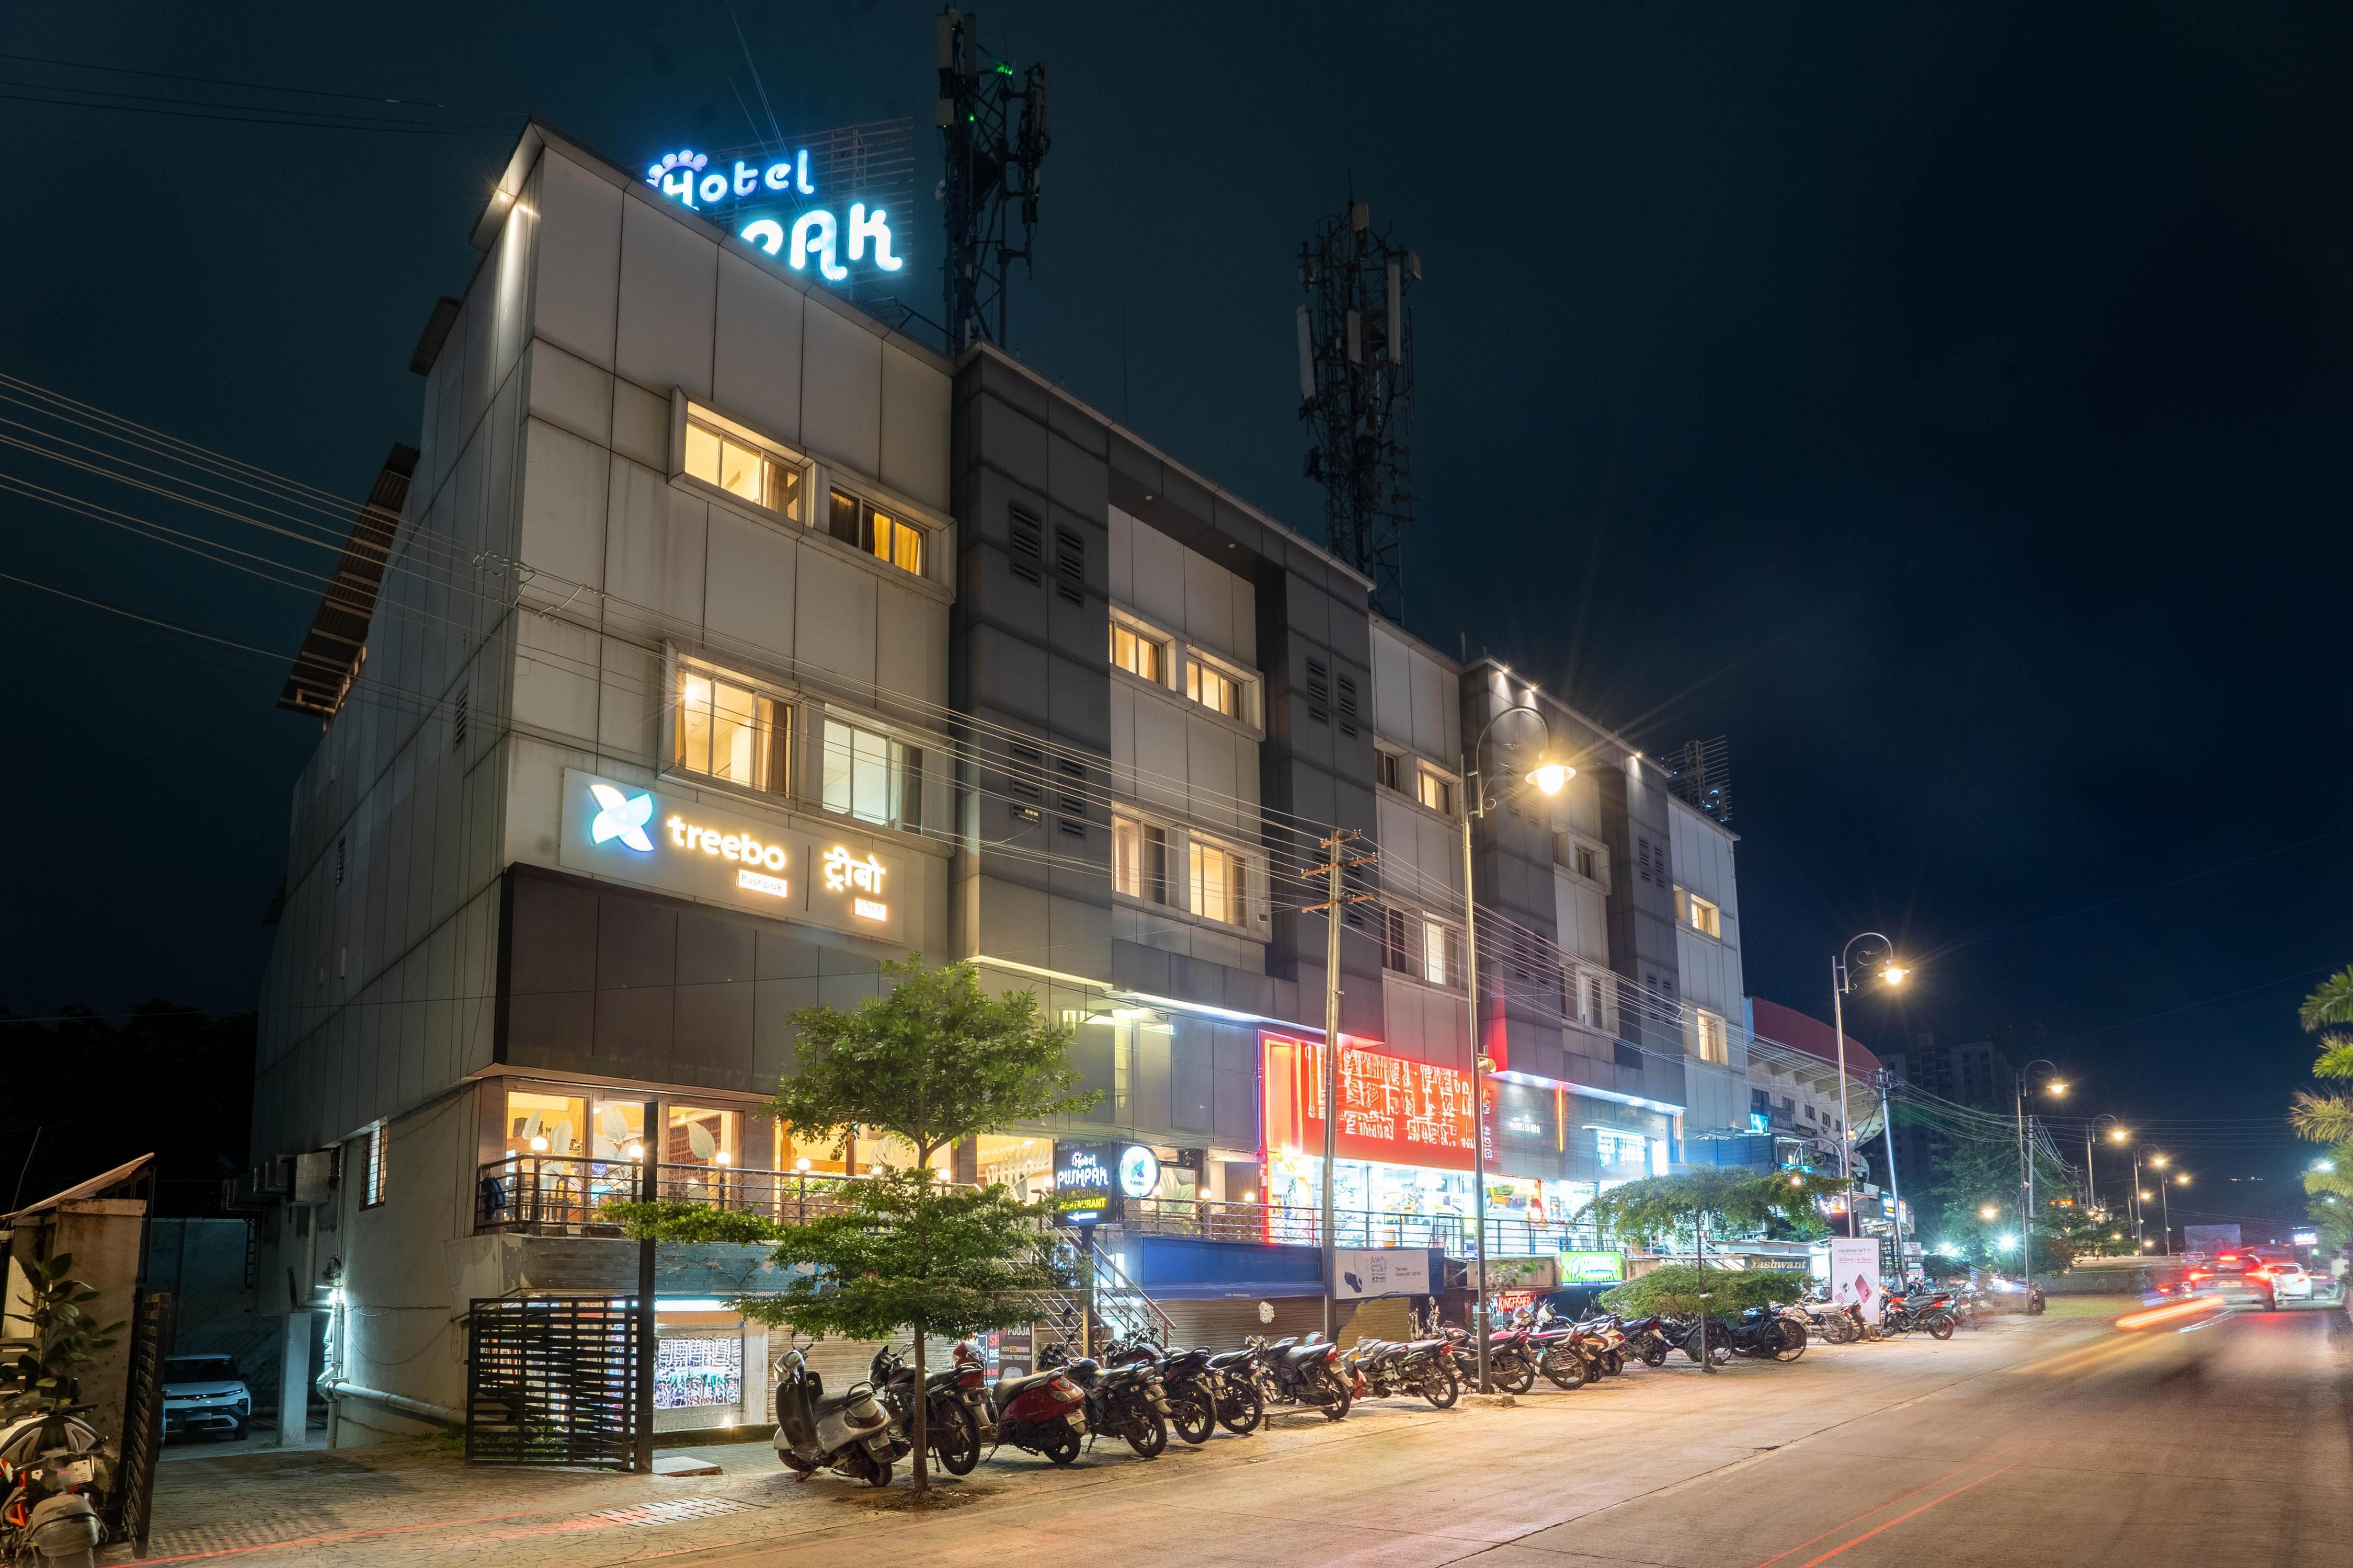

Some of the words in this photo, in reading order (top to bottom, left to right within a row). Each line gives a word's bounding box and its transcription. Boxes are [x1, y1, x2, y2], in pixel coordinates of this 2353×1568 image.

[664, 150, 815, 211] Hotel
[667, 815, 786, 870] treebo
[823, 845, 886, 894] ट्रीबो
[741, 874, 782, 891] Pushpak
[1075, 1154, 1096, 1169] Hotel
[1057, 1166, 1109, 1189] PUSHPAK
[1751, 1257, 1807, 1269] Yashwant
[1498, 1296, 1530, 1312] KINGFISHER
[1008, 1326, 1031, 1336] POOJA
